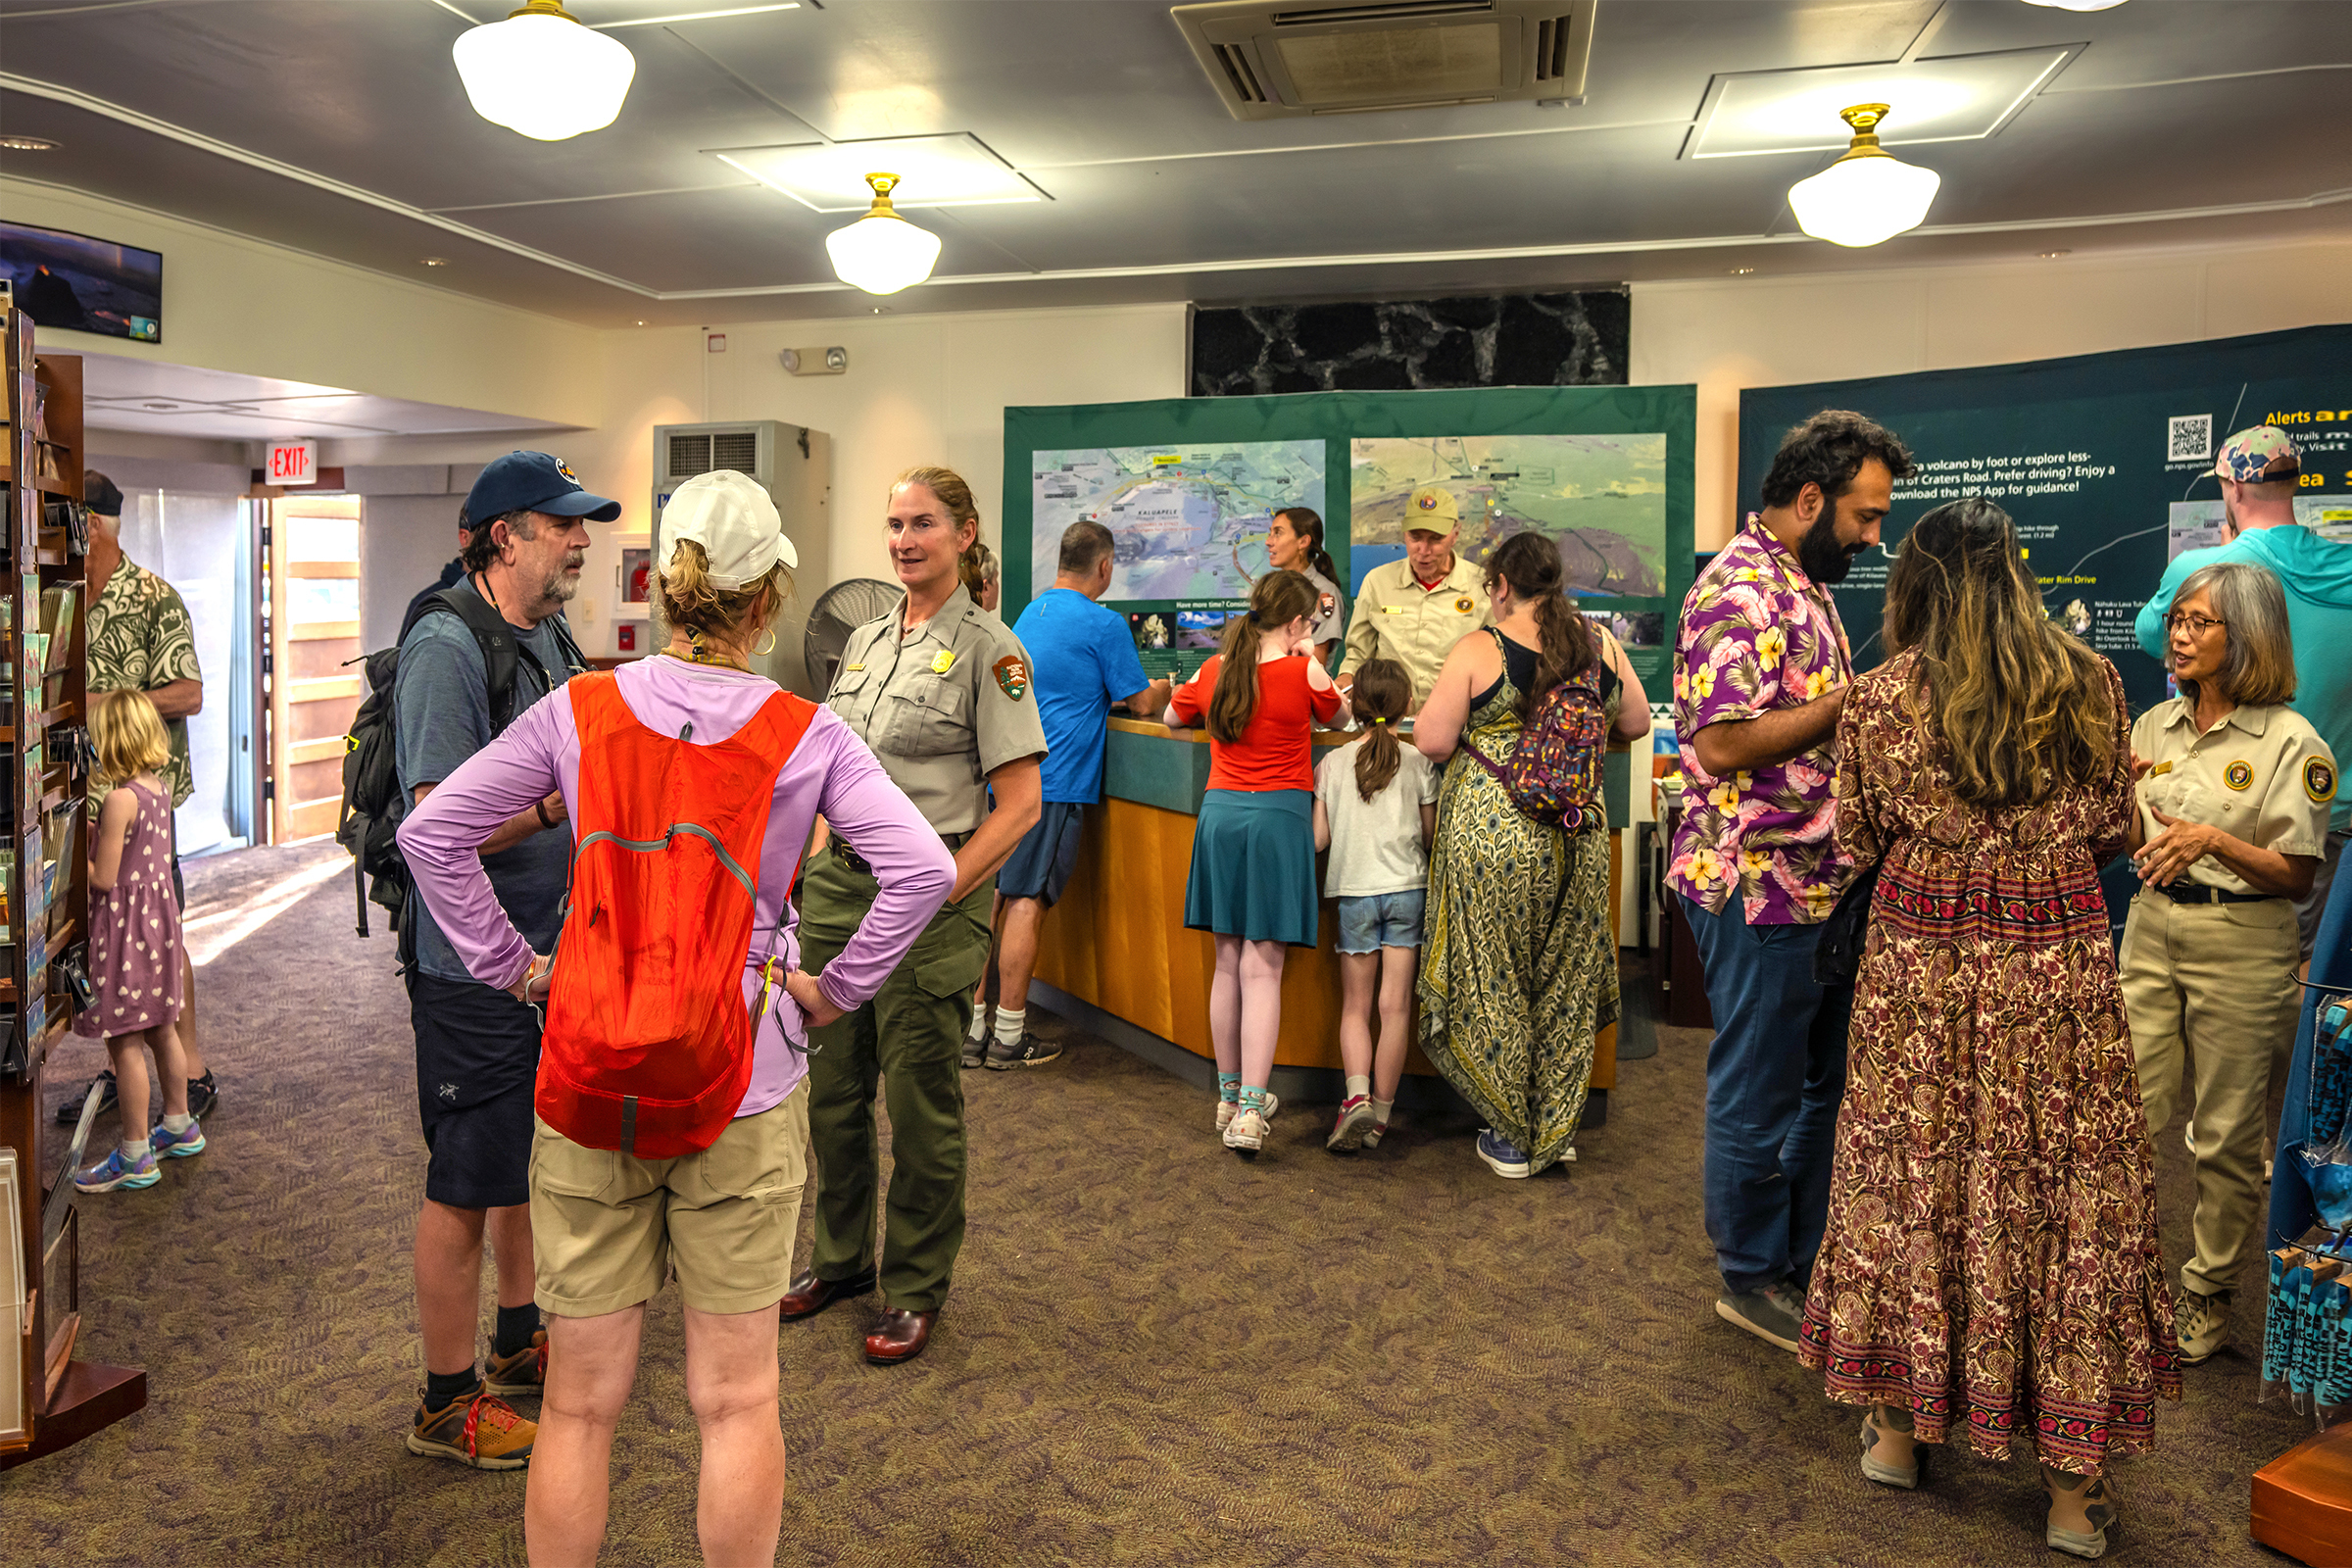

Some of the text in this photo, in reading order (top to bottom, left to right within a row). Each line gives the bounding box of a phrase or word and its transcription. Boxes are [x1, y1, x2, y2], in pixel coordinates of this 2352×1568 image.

[2265, 410, 2311, 426] Alerts
[2296, 431, 2319, 441] trails
[2309, 442, 2348, 452] Visit
[274, 447, 305, 477] EXIT
[1927, 459, 1969, 471] volcano
[1972, 458, 1984, 471] by
[1986, 456, 2008, 468] foot
[2010, 458, 2023, 466] or
[2025, 454, 2065, 466] explore
[2068, 451, 2091, 463] less-
[1906, 475, 1919, 486] of
[1921, 473, 1961, 485] Craters
[1963, 471, 1991, 483] Road.
[1994, 469, 2026, 481] Prefer
[2028, 466, 2073, 480] driving?
[2075, 464, 2105, 479] Enjoy
[2108, 466, 2116, 474] a
[1889, 480, 2080, 501] ownload the NPS App for guidance!
[2056, 575, 2073, 584] Rim
[2074, 574, 2097, 584] Drive
